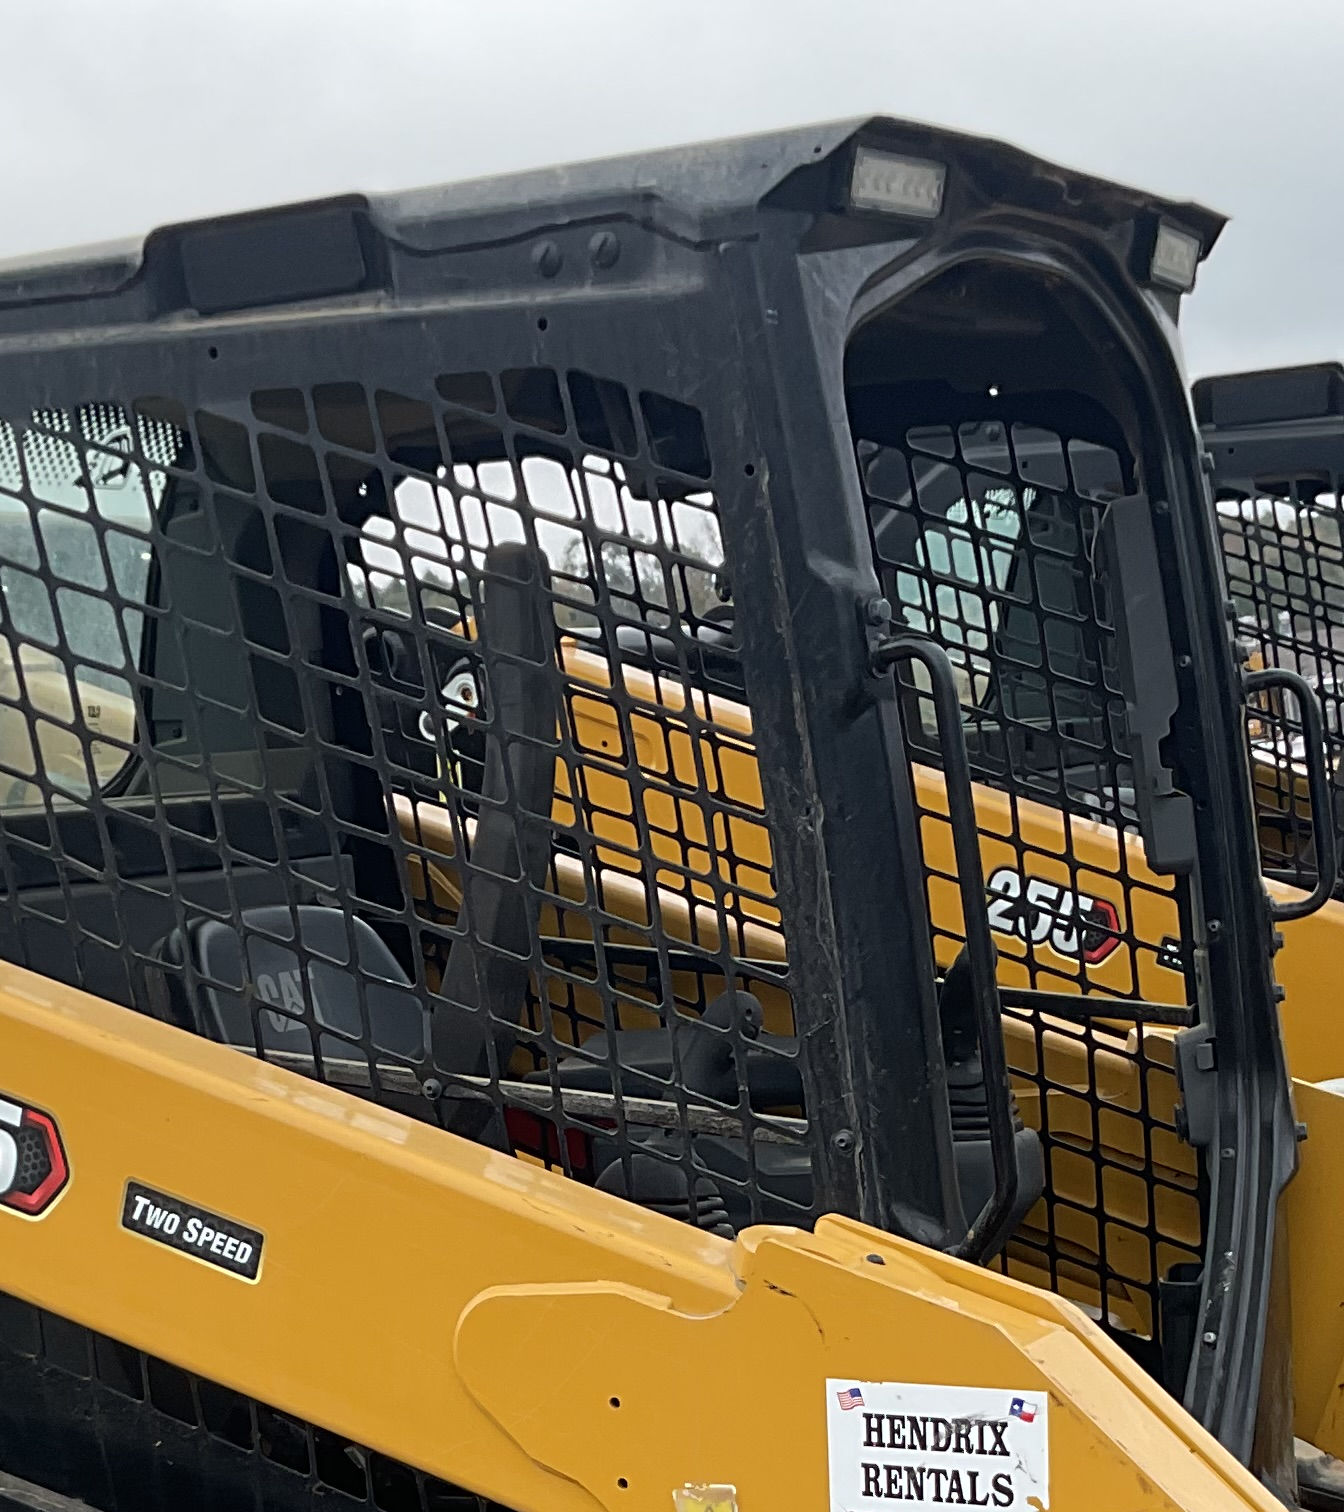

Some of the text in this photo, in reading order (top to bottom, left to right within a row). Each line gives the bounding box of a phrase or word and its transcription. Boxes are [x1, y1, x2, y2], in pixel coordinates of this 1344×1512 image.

[986, 869, 1094, 952] 255
[257, 967, 325, 1033] CAT
[862, 1412, 1011, 1457] HENDRIX
[861, 1462, 1014, 1508] RENTALS
